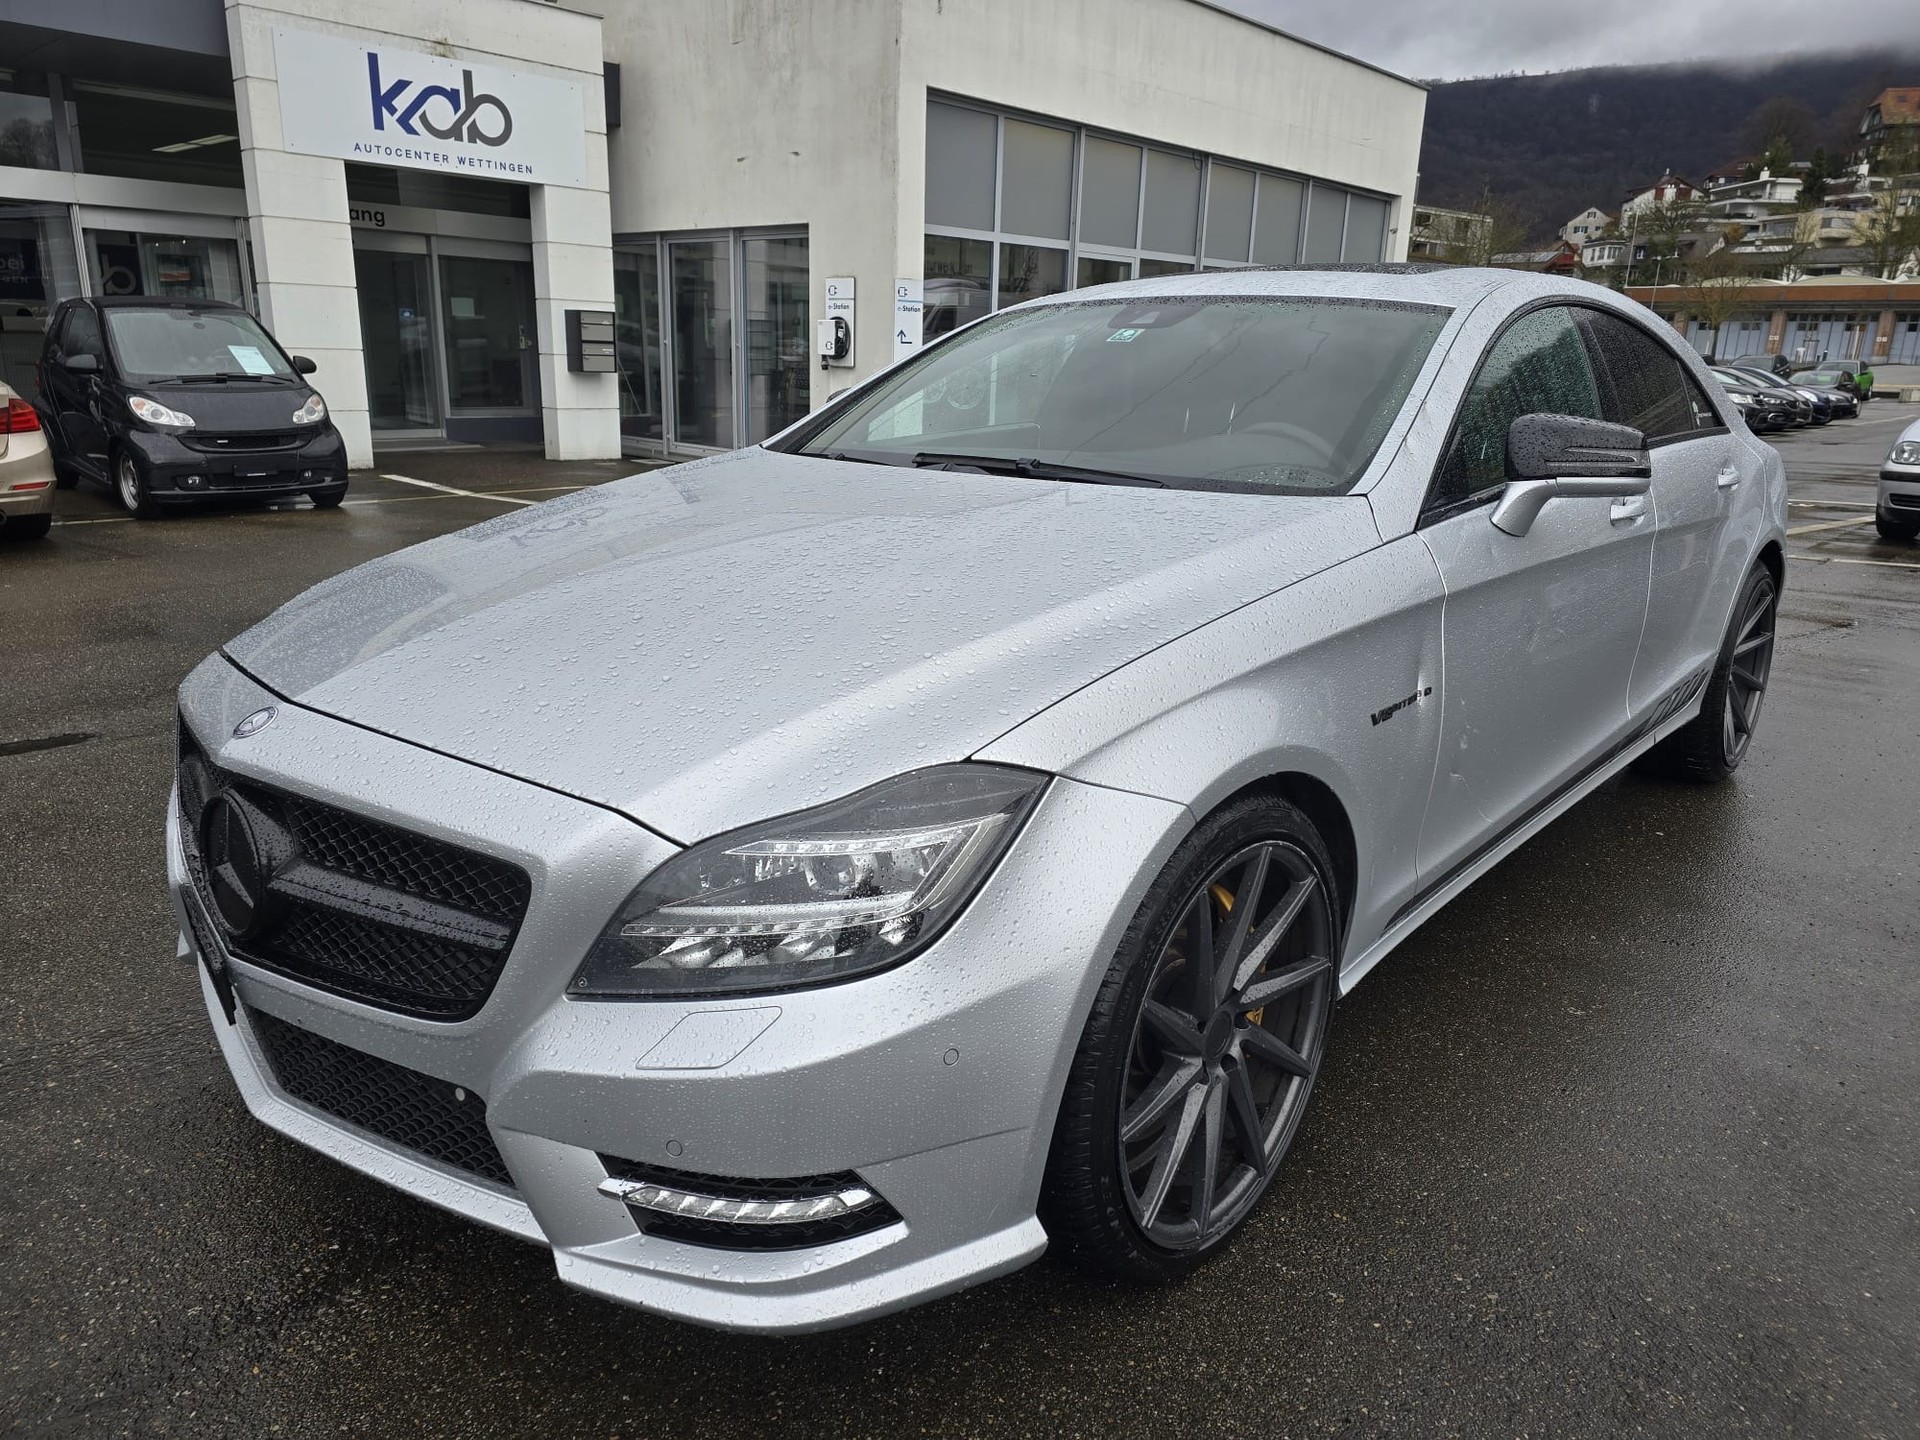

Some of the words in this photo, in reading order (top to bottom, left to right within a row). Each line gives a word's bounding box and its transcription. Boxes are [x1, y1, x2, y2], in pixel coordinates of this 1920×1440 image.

[366, 51, 513, 148] kab
[353, 142, 450, 164] AUTOCENTER
[457, 156, 534, 175] WETTINGEN
